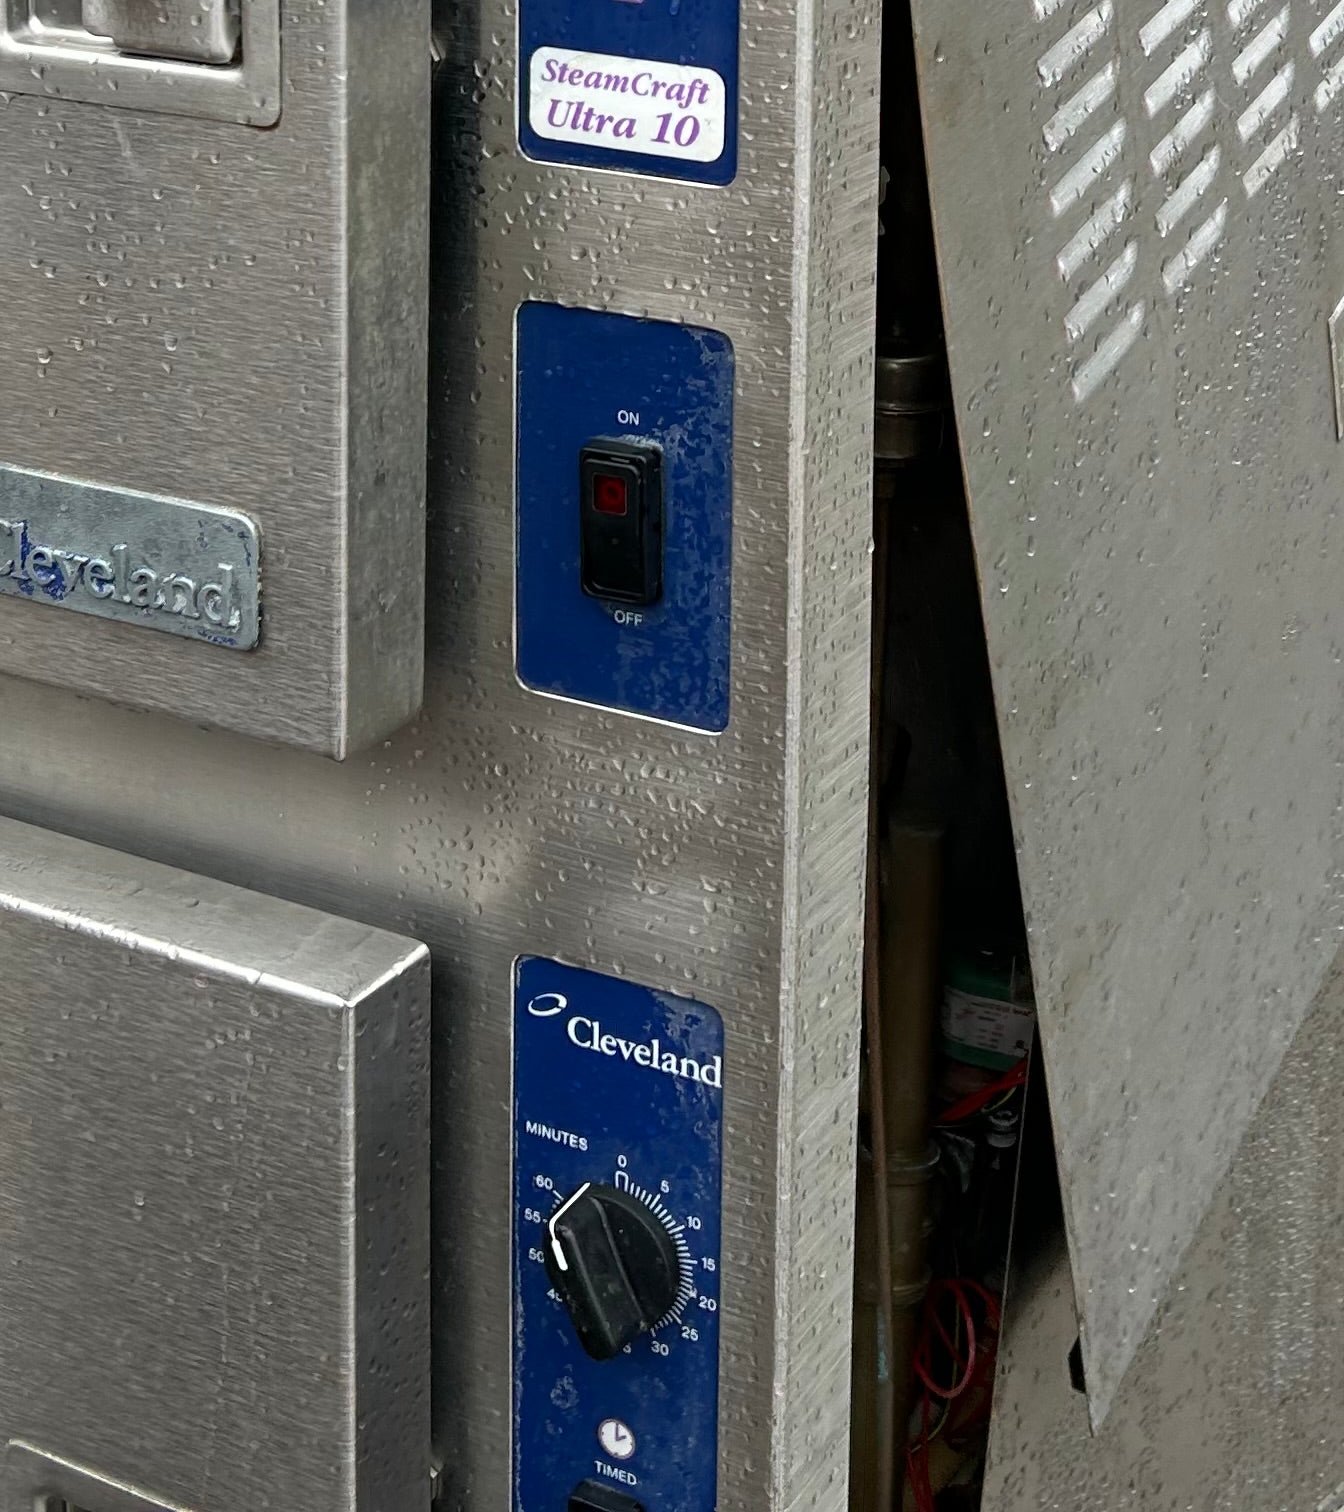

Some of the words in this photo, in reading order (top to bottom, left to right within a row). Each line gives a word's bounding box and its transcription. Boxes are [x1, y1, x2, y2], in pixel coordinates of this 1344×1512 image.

[541, 57, 712, 106] SteamCraft
[547, 98, 637, 141] Ultra
[650, 110, 703, 149] 10
[617, 408, 640, 426] ON
[614, 609, 644, 627] OFF
[567, 1016, 723, 1088] Cleveland
[525, 1120, 588, 1152] MINUTES
[617, 1154, 628, 1169] 0
[535, 1174, 554, 1190] 60
[660, 1179, 670, 1194] 5
[524, 1208, 541, 1223] 55
[686, 1215, 702, 1231] 10
[528, 1248, 545, 1263] 50
[701, 1255, 717, 1272] 15
[698, 1295, 717, 1312] 20
[680, 1326, 699, 1342] 25
[650, 1341, 669, 1357] 30
[594, 1459, 637, 1486] TIMED
